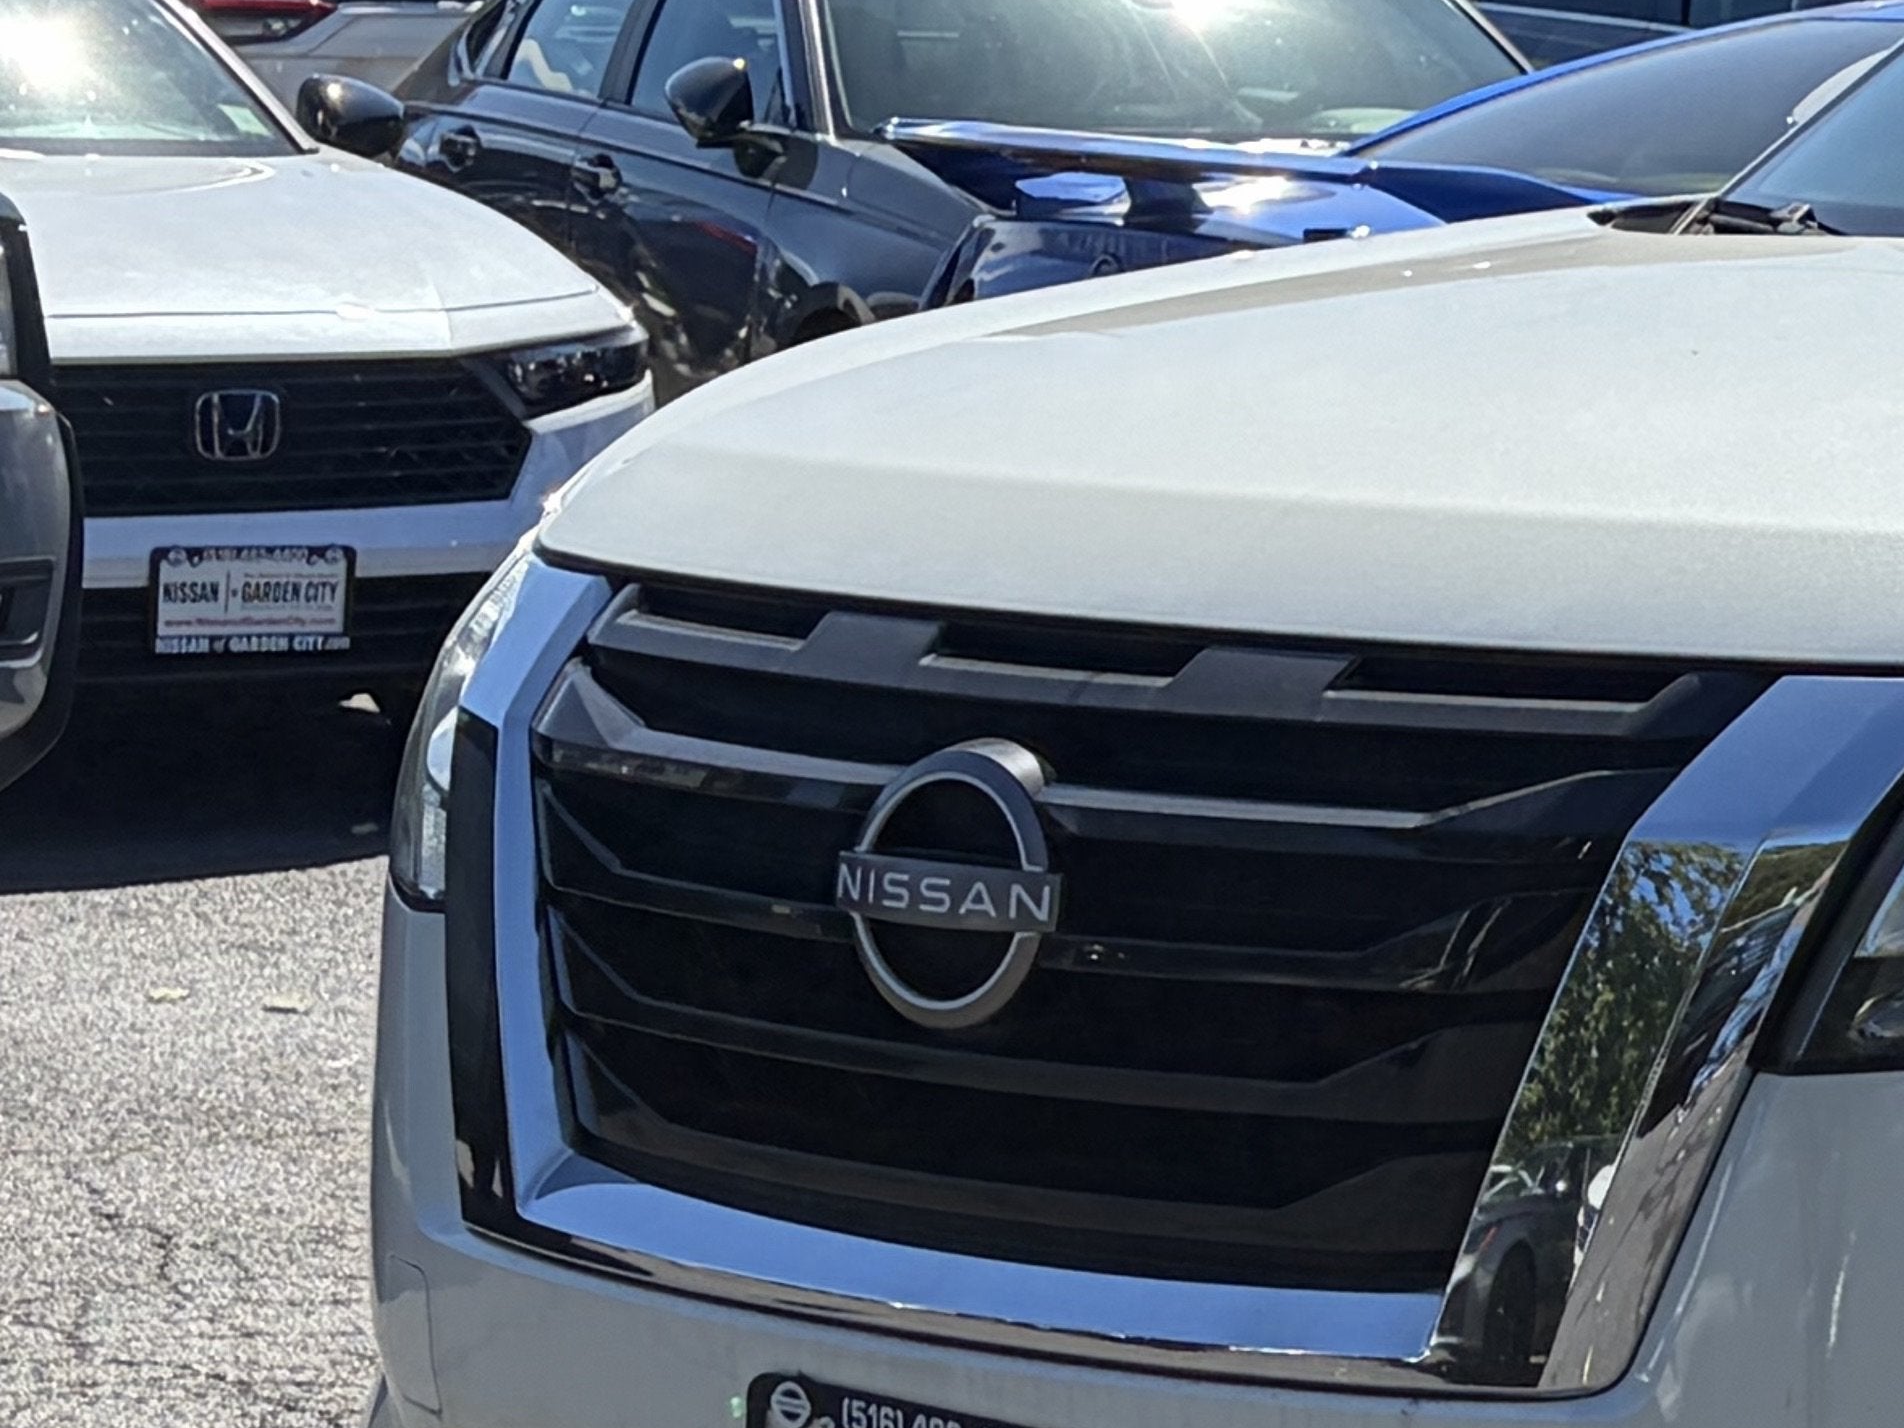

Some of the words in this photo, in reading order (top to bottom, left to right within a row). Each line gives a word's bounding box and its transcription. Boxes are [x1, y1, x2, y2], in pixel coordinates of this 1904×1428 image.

[162, 580, 220, 604] NISSAN
[241, 580, 301, 603] GARDEN
[304, 579, 339, 603] CITY
[836, 862, 1052, 923] NISSAN
